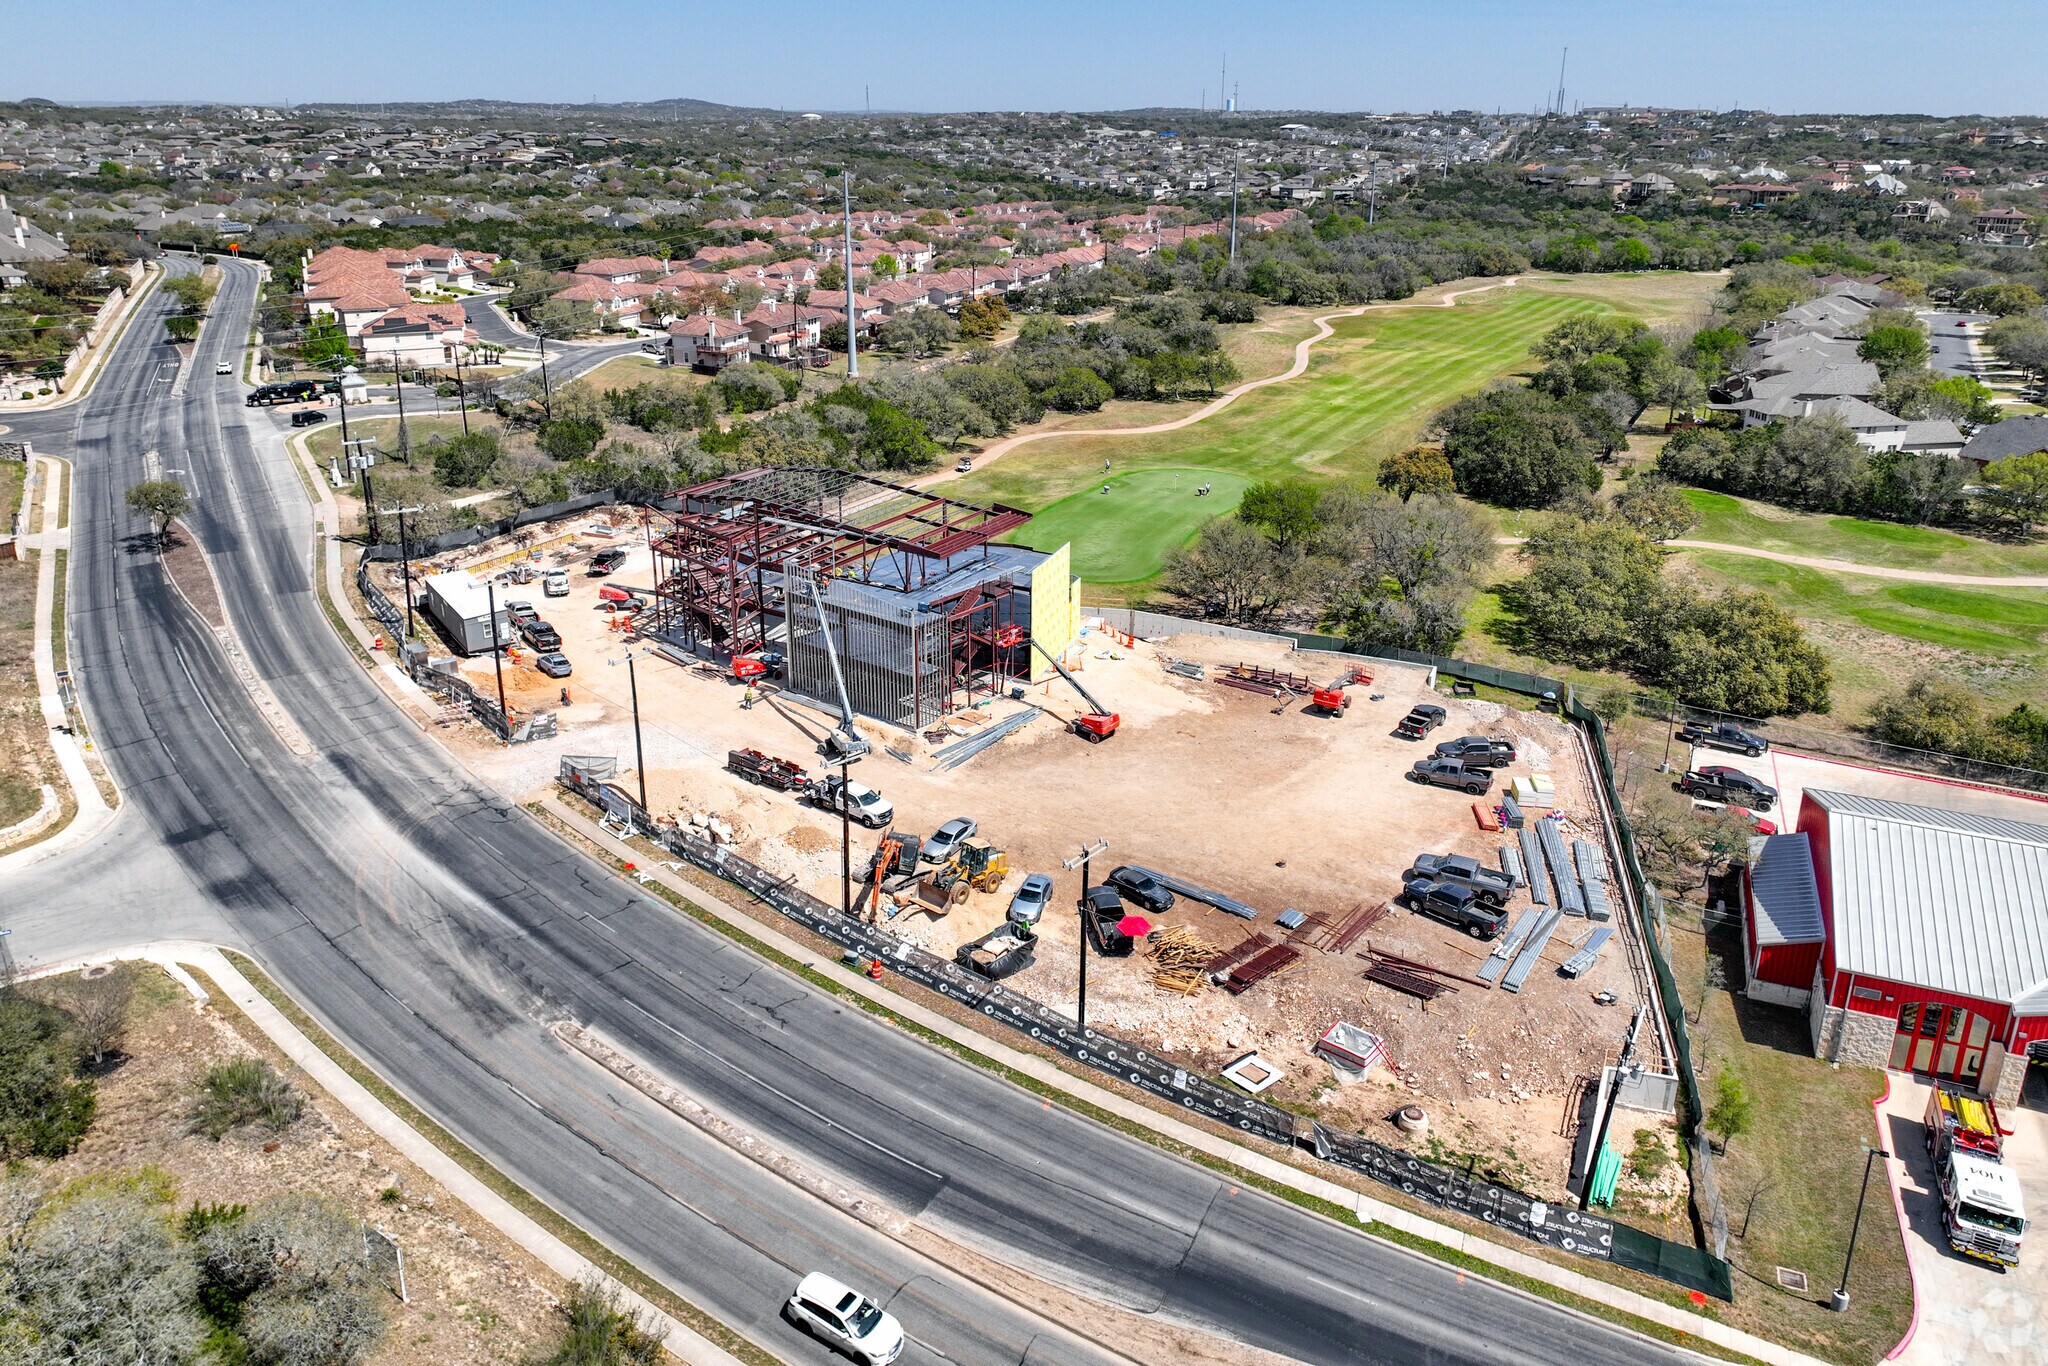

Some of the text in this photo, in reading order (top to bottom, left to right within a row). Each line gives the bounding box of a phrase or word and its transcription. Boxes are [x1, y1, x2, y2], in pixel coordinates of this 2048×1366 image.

[1041, 1033, 1070, 1050] STRUCTURE TONE
[1068, 1034, 1099, 1051] STRUCTURE TONE
[1089, 1056, 1111, 1069] STRUCTURE
[1111, 1065, 1121, 1073] TONE
[1119, 1057, 1140, 1069] STRUCTURE
[1140, 1066, 1151, 1075] TONE
[1148, 1058, 1168, 1071] STRUCTURE
[1141, 1079, 1163, 1092] STRUCTURE
[1163, 1089, 1174, 1097] TONE
[1200, 1082, 1223, 1094] STRUCTURE
[1223, 1091, 1234, 1100] TONE
[1196, 1102, 1218, 1116] STRUCTURE
[1546, 1222, 1573, 1234] STRUCTURE
[1573, 1229, 1587, 1237] TONE
[1581, 1218, 1610, 1229] STRUCTURE
[1578, 1244, 1607, 1256] STRUCTURE
